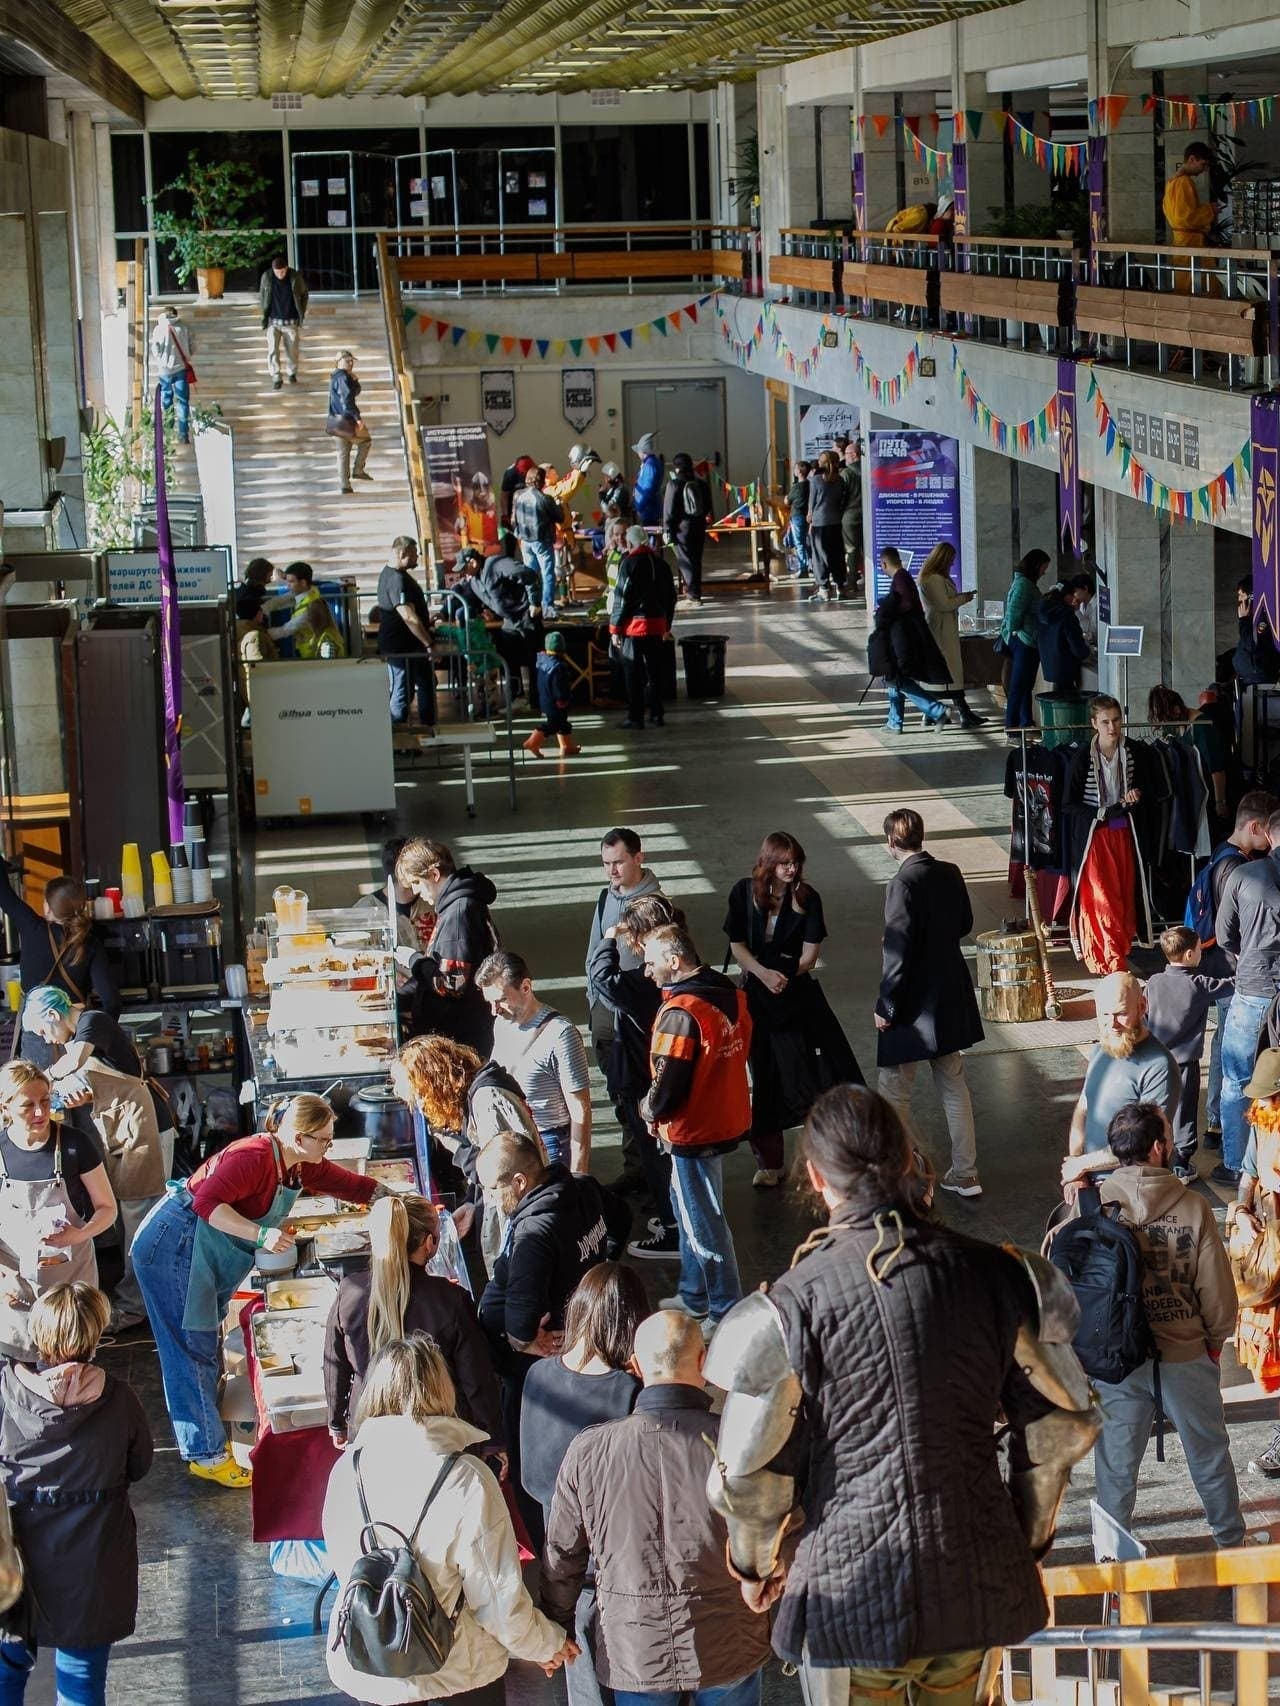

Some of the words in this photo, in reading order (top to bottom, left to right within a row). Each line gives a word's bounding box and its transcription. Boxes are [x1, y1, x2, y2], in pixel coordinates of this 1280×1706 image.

[879, 438, 908, 448] ПУТЬ
[878, 447, 907, 457] МЕЧА
[138, 581, 153, 591] ДС
